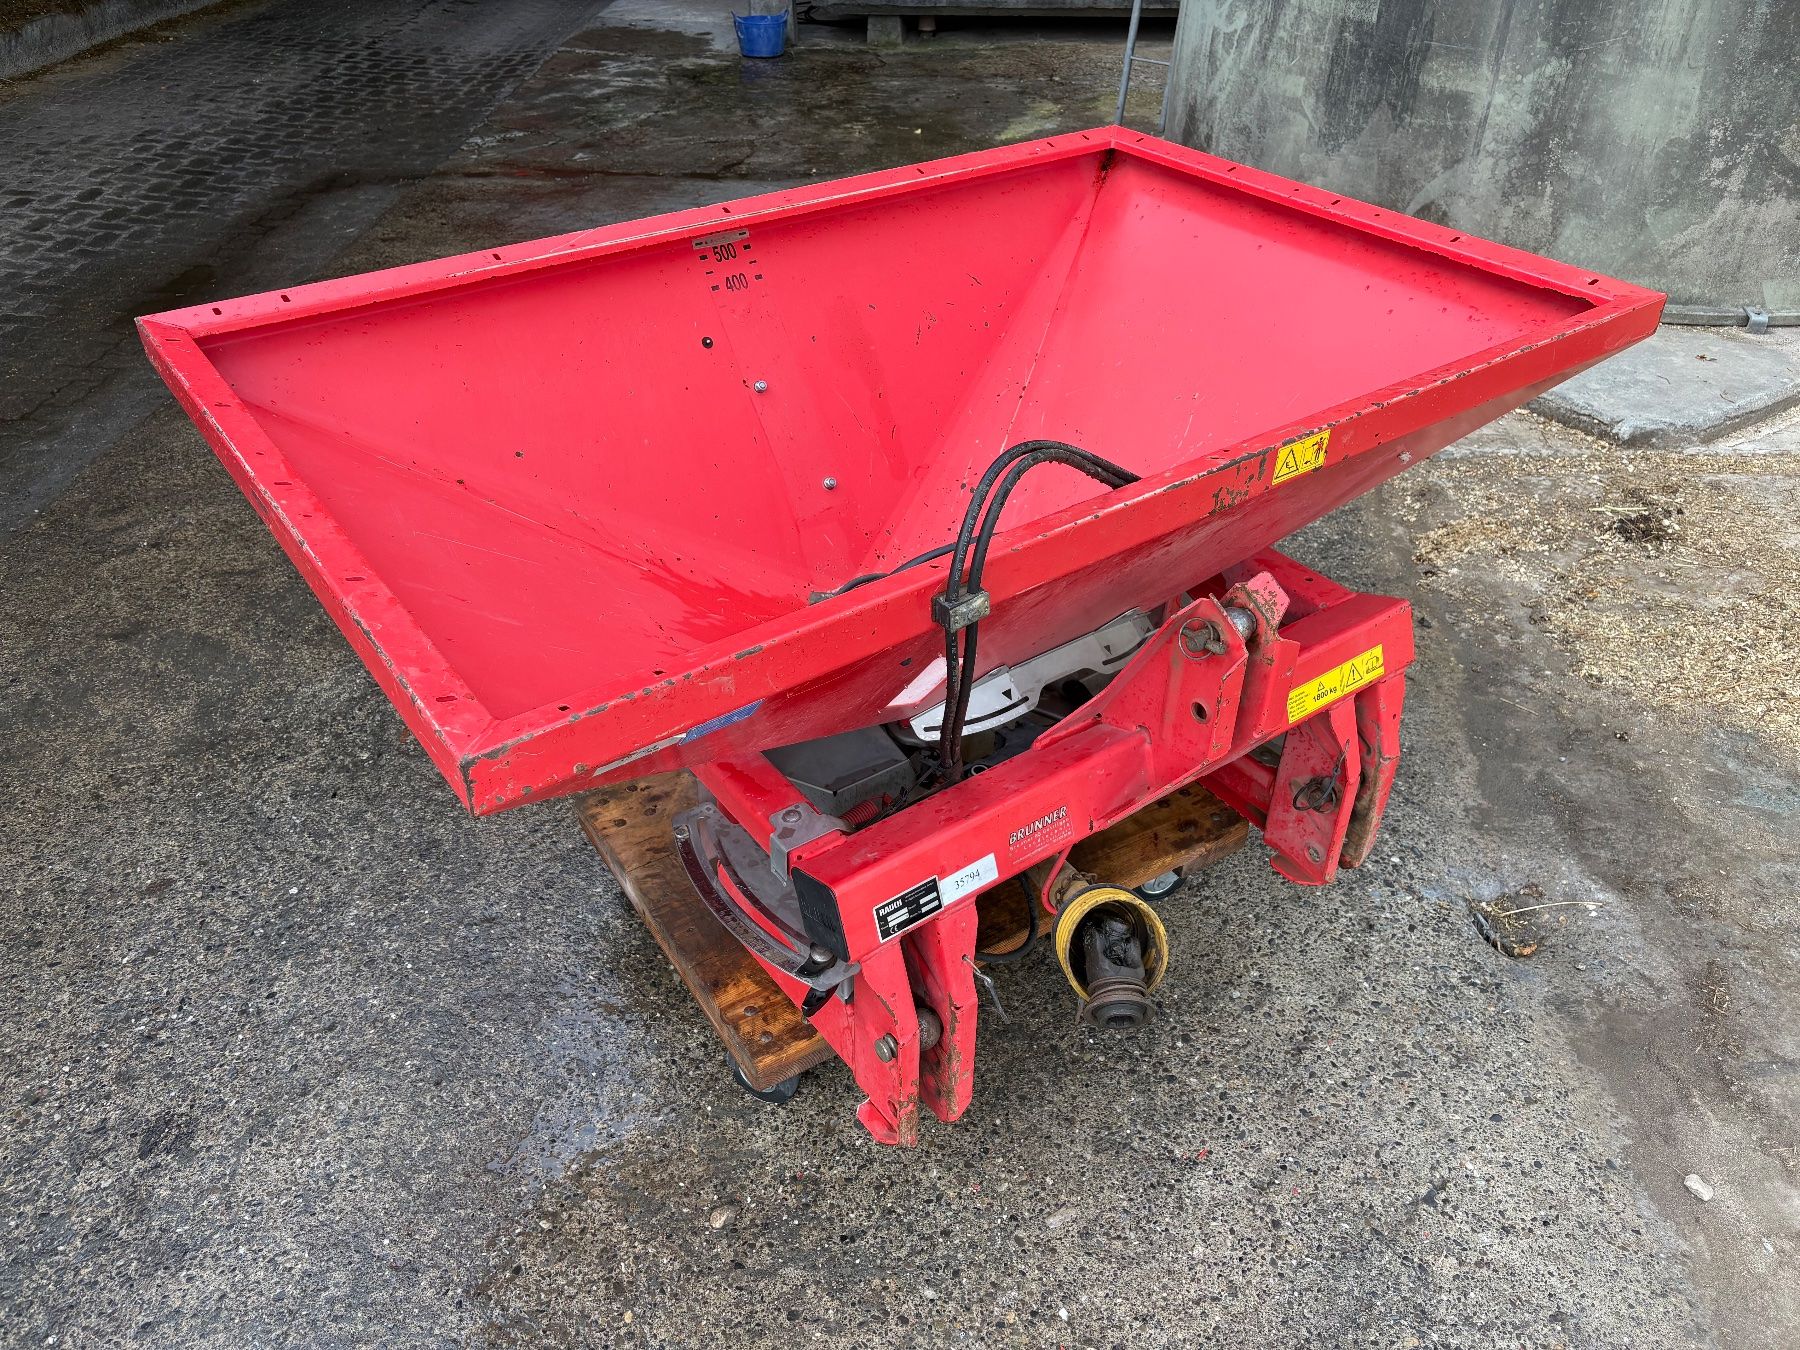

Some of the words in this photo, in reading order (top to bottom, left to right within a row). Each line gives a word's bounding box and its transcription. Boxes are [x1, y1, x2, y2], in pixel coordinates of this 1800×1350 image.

[712, 243, 737, 262] 500
[725, 273, 748, 291] 400
[1313, 690, 1328, 702] 1800
[1329, 686, 1337, 694] kg
[1009, 806, 1067, 846] BRUNNER
[955, 869, 980, 890] 35794
[879, 899, 902, 916] RAUCH
